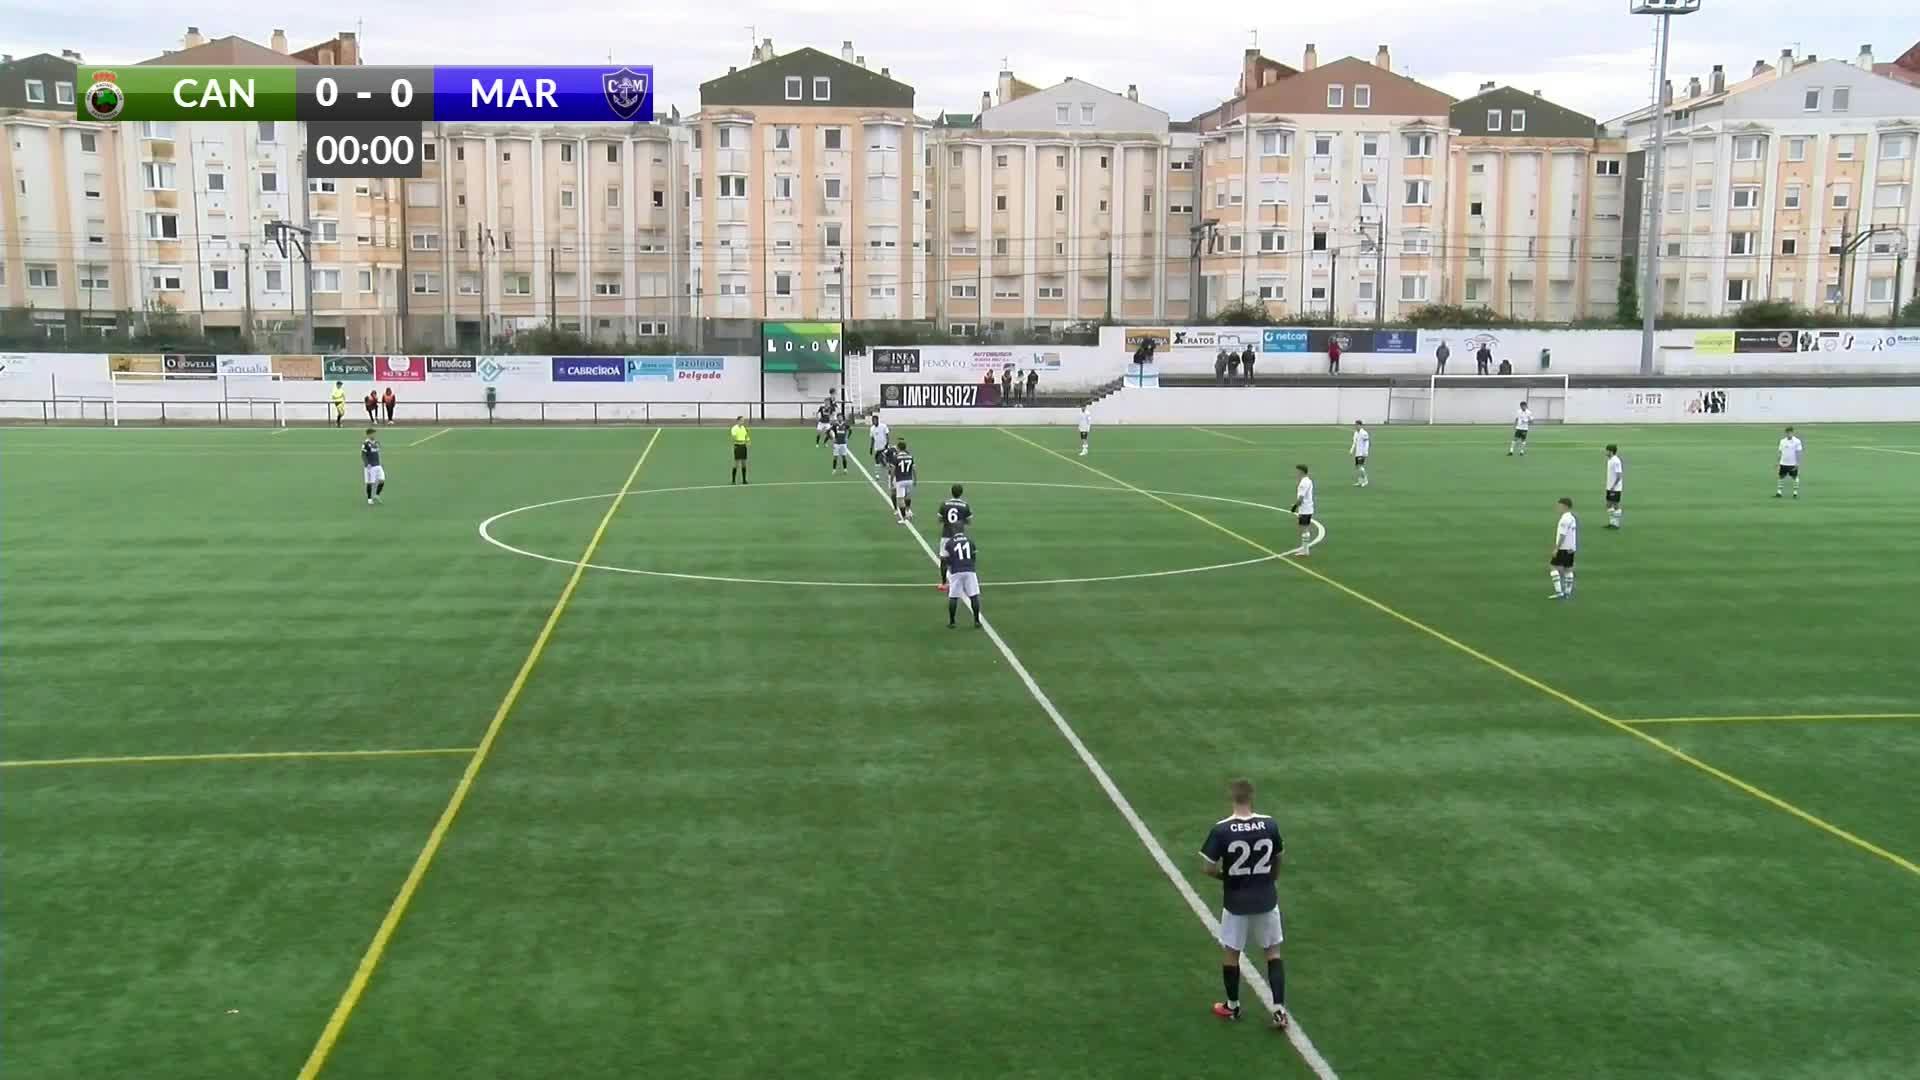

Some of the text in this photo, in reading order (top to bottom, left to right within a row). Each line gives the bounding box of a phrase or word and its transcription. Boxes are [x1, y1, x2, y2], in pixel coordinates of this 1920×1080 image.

[767, 339, 777, 352] L
[785, 341, 793, 351] 0
[811, 341, 819, 351] 0
[826, 339, 839, 352] V
[678, 371, 721, 381] Delgado
[903, 386, 977, 406] IMPULSO27
[898, 459, 913, 473] 17
[947, 507, 958, 523] 6
[953, 541, 971, 560] 11
[1230, 821, 1266, 832] CESAR
[1227, 838, 1273, 876] 22
